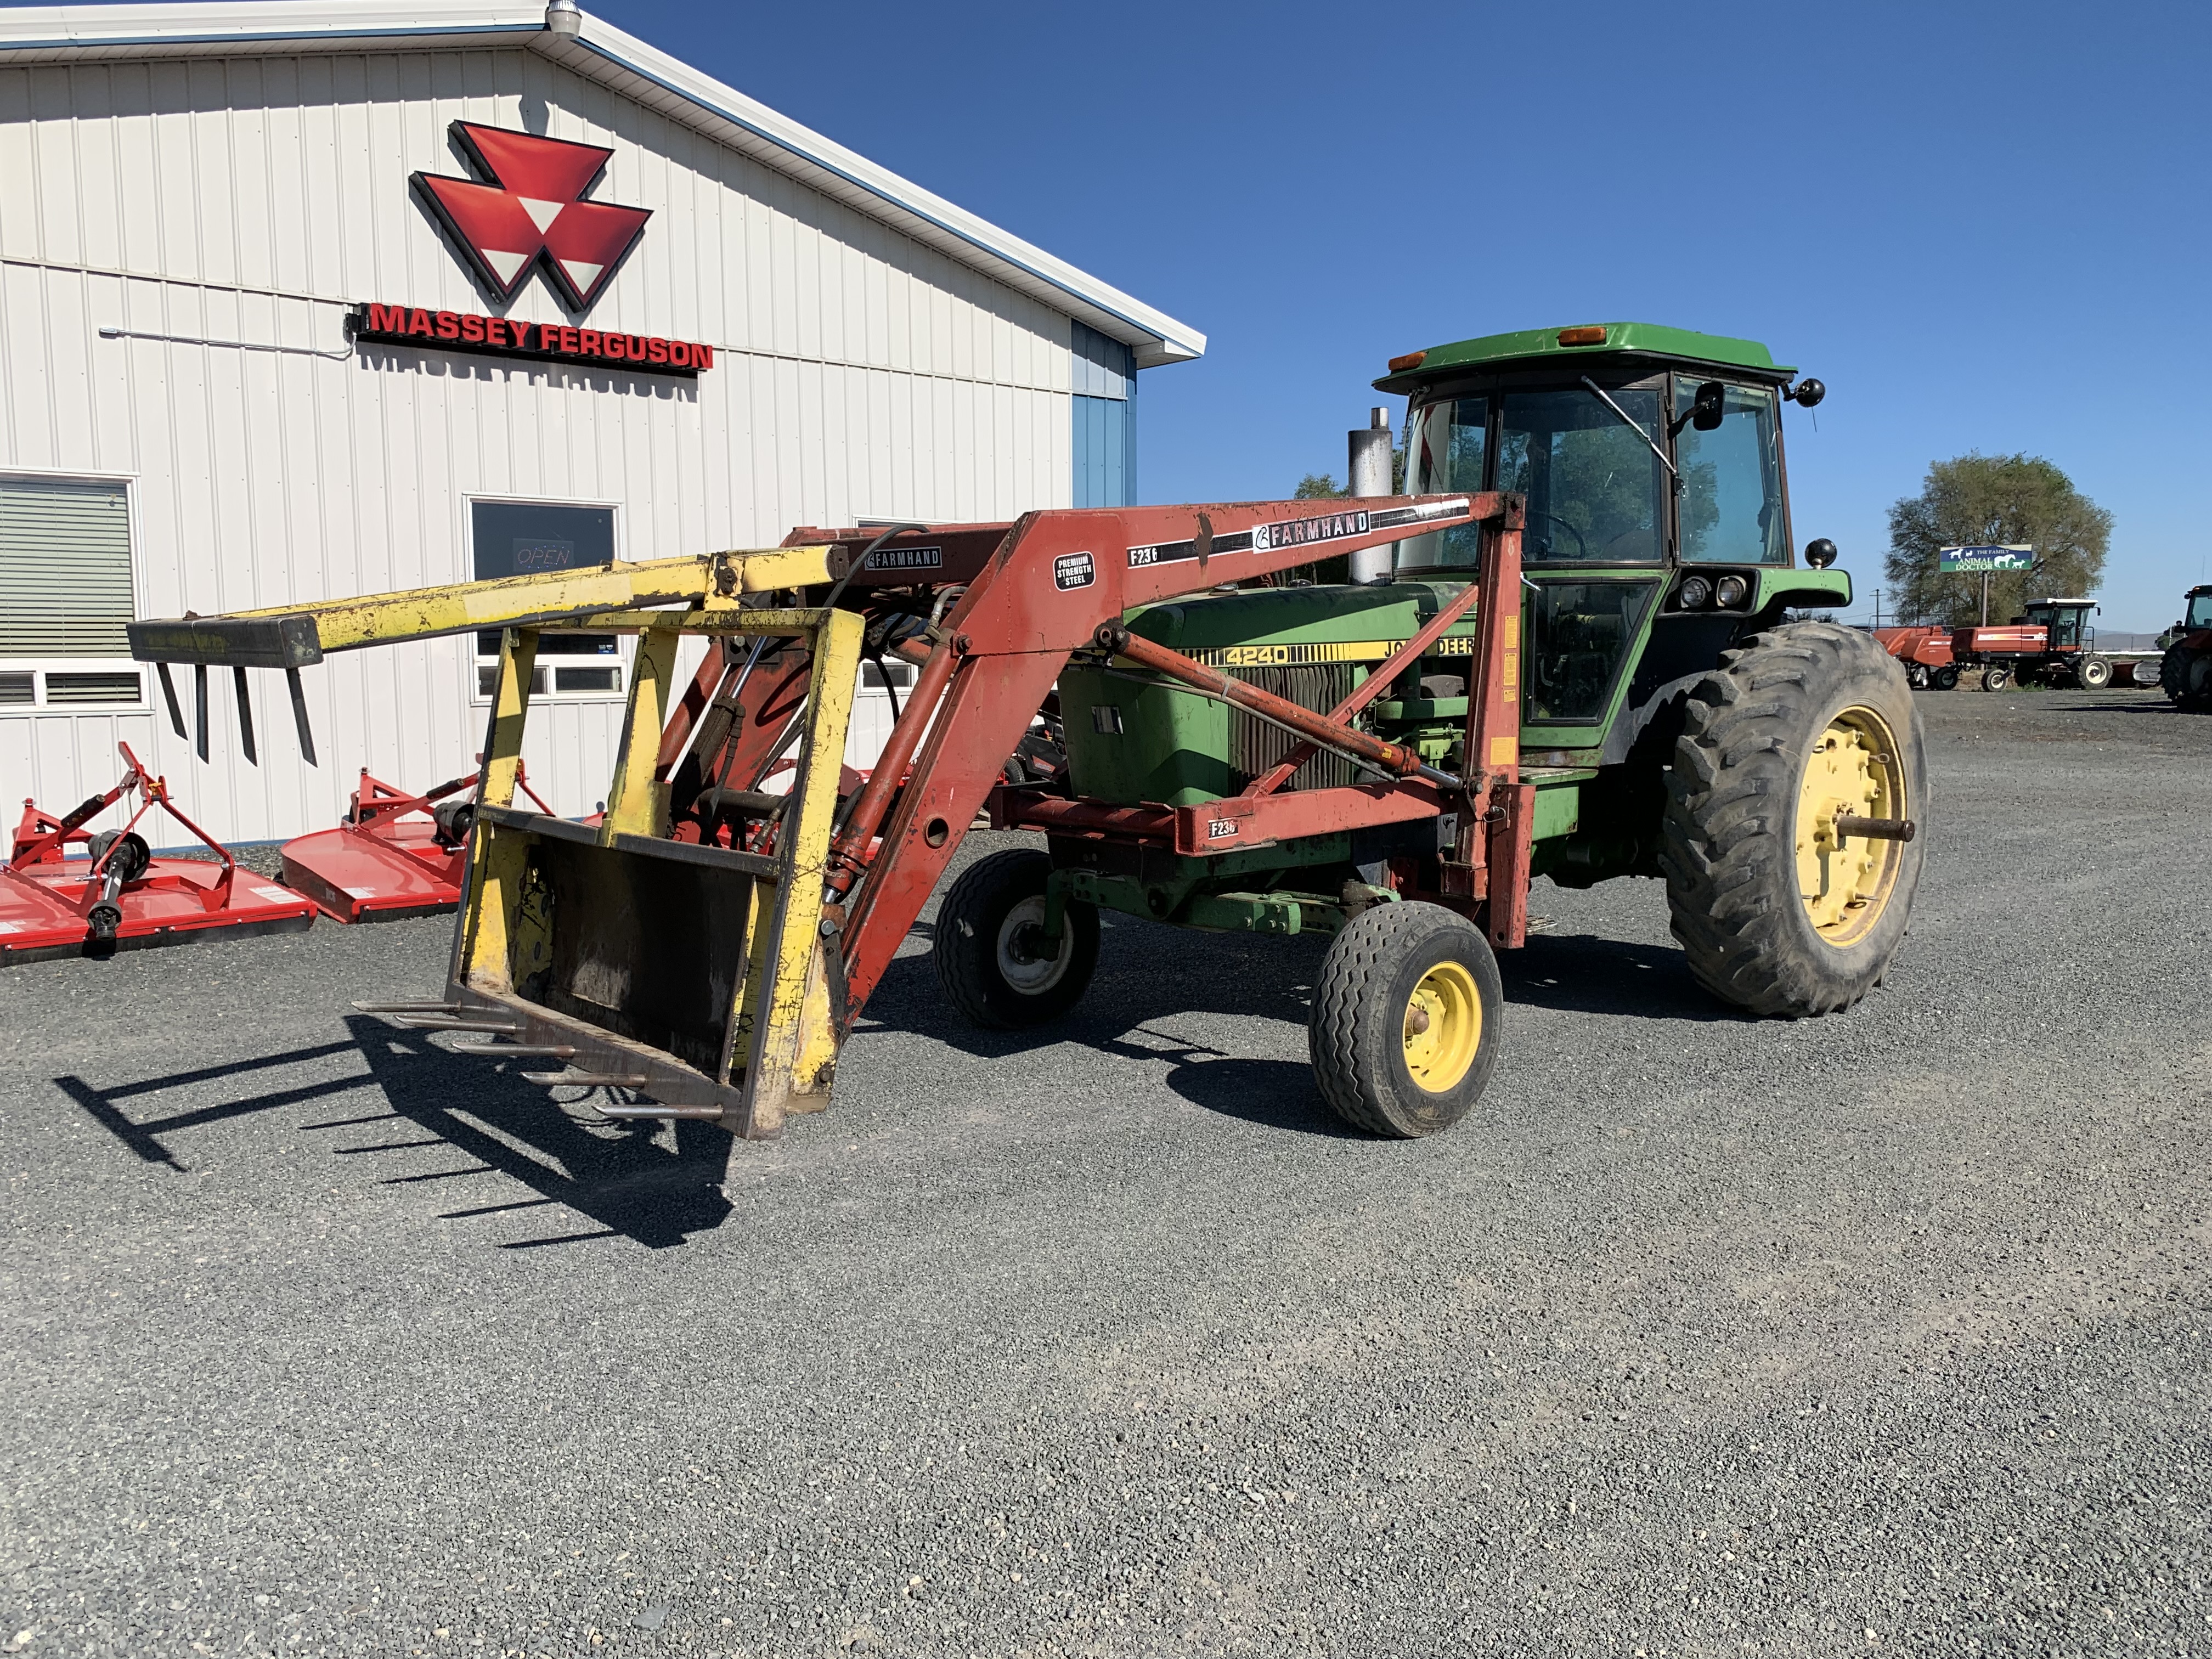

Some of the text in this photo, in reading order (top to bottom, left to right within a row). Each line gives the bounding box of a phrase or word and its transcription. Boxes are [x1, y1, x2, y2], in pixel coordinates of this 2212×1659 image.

[370, 303, 713, 369] MASSEY FERGUSON
[1271, 512, 1367, 546] FARMHAND
[517, 549, 570, 565] OPEN
[876, 550, 939, 567] FARMHAND
[1058, 556, 1089, 569] PREMIUM
[1130, 548, 1158, 565] F236
[1057, 565, 1092, 578] STRENGTH
[1065, 574, 1086, 586] STEEL
[1438, 638, 1475, 654] DEER
[1227, 646, 1289, 665] 4240
[1211, 821, 1235, 836] F236
